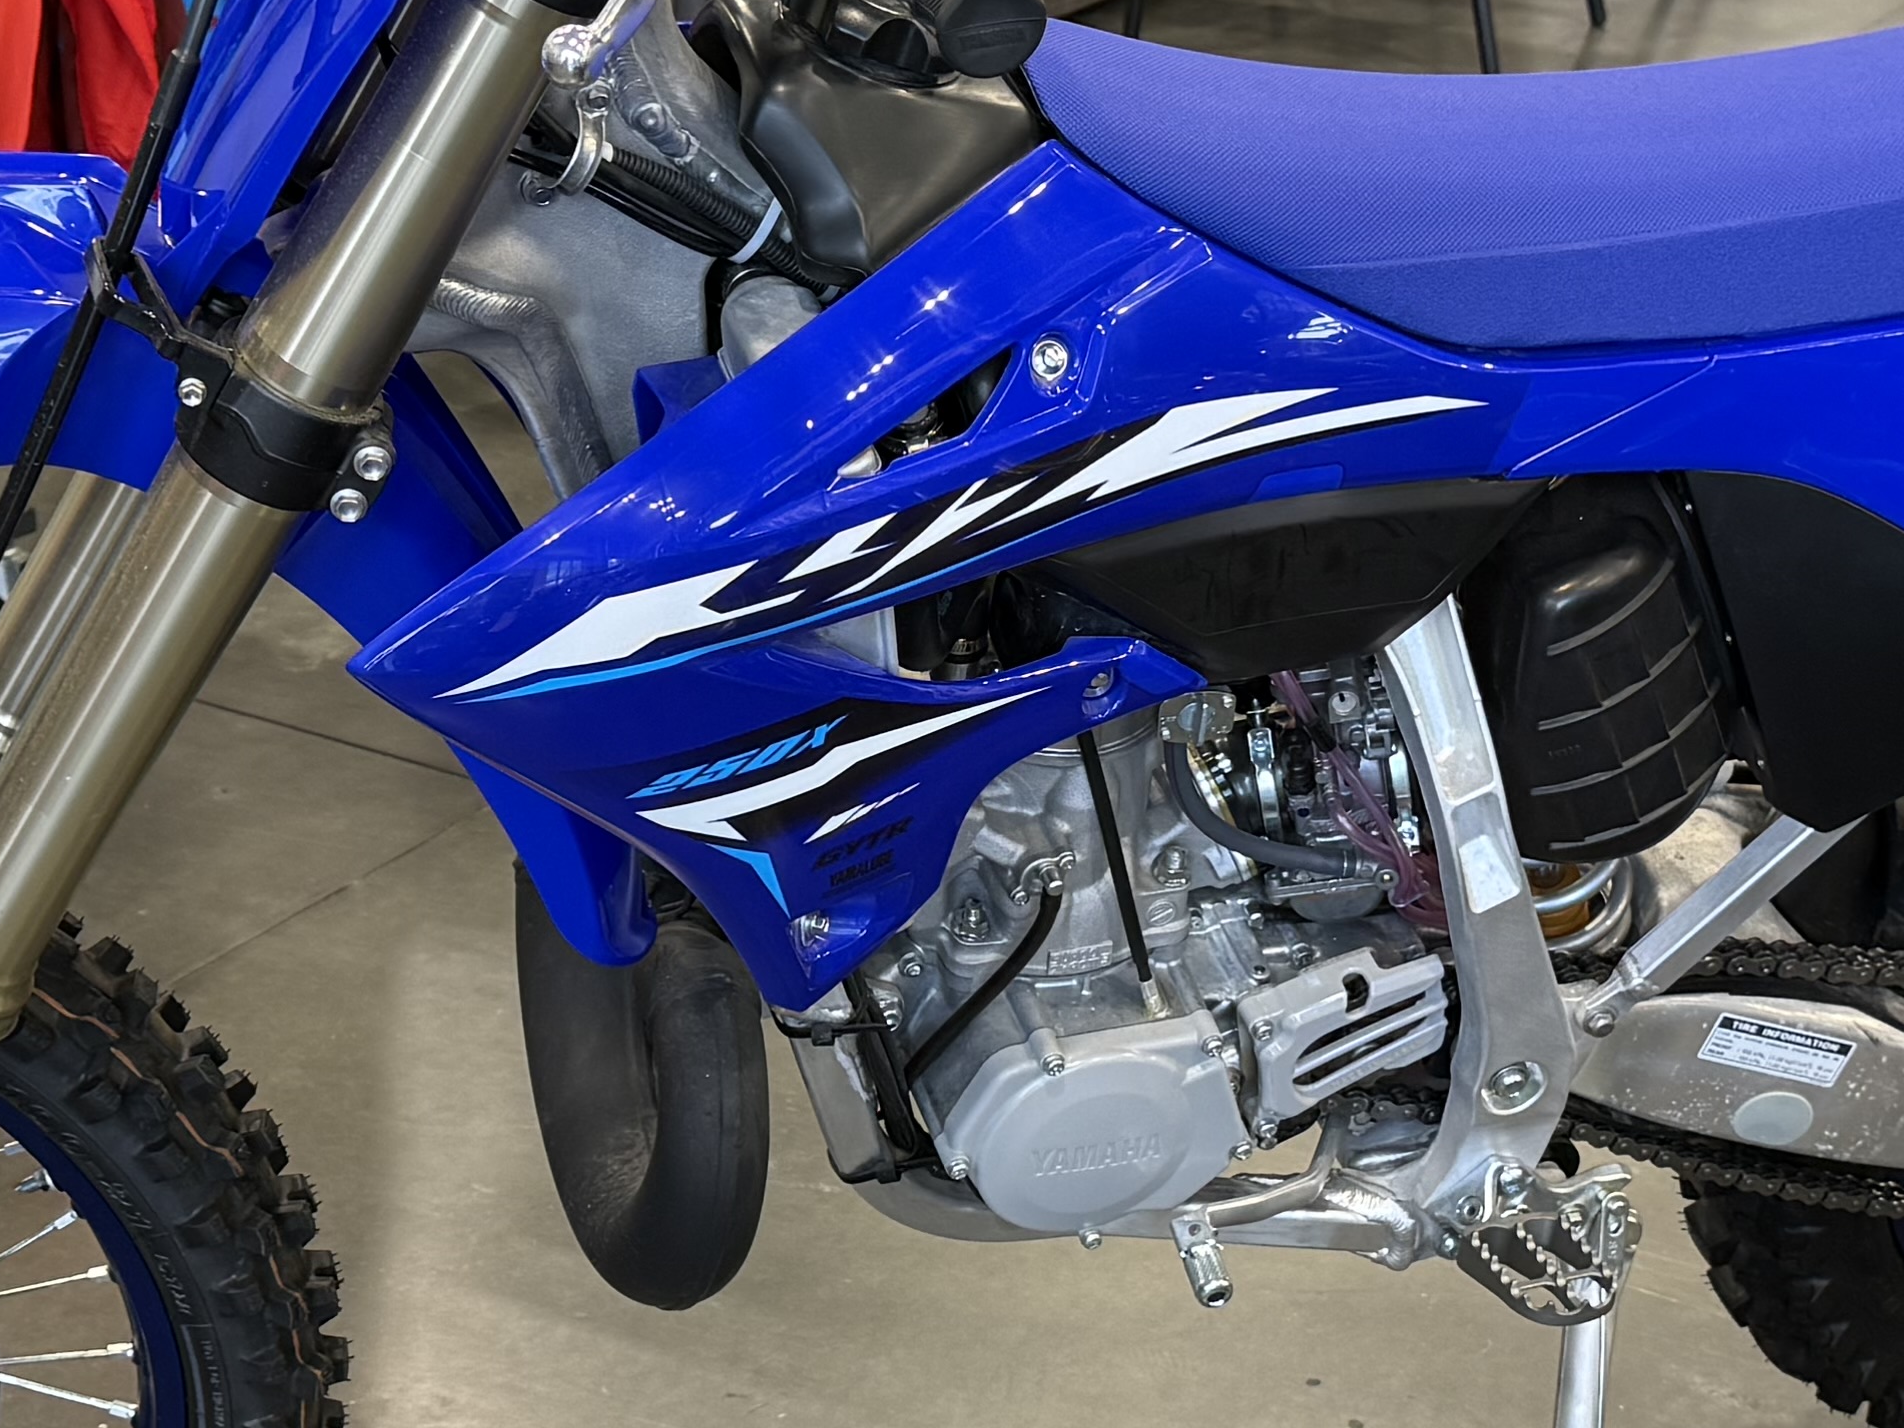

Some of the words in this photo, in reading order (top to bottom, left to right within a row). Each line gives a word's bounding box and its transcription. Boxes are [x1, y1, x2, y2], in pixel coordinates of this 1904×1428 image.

[625, 712, 853, 799] 250X
[1731, 1021, 1759, 1034] TIRE
[1762, 1029, 1841, 1052] INFORMATION
[1031, 1133, 1162, 1177] YAMAHA
